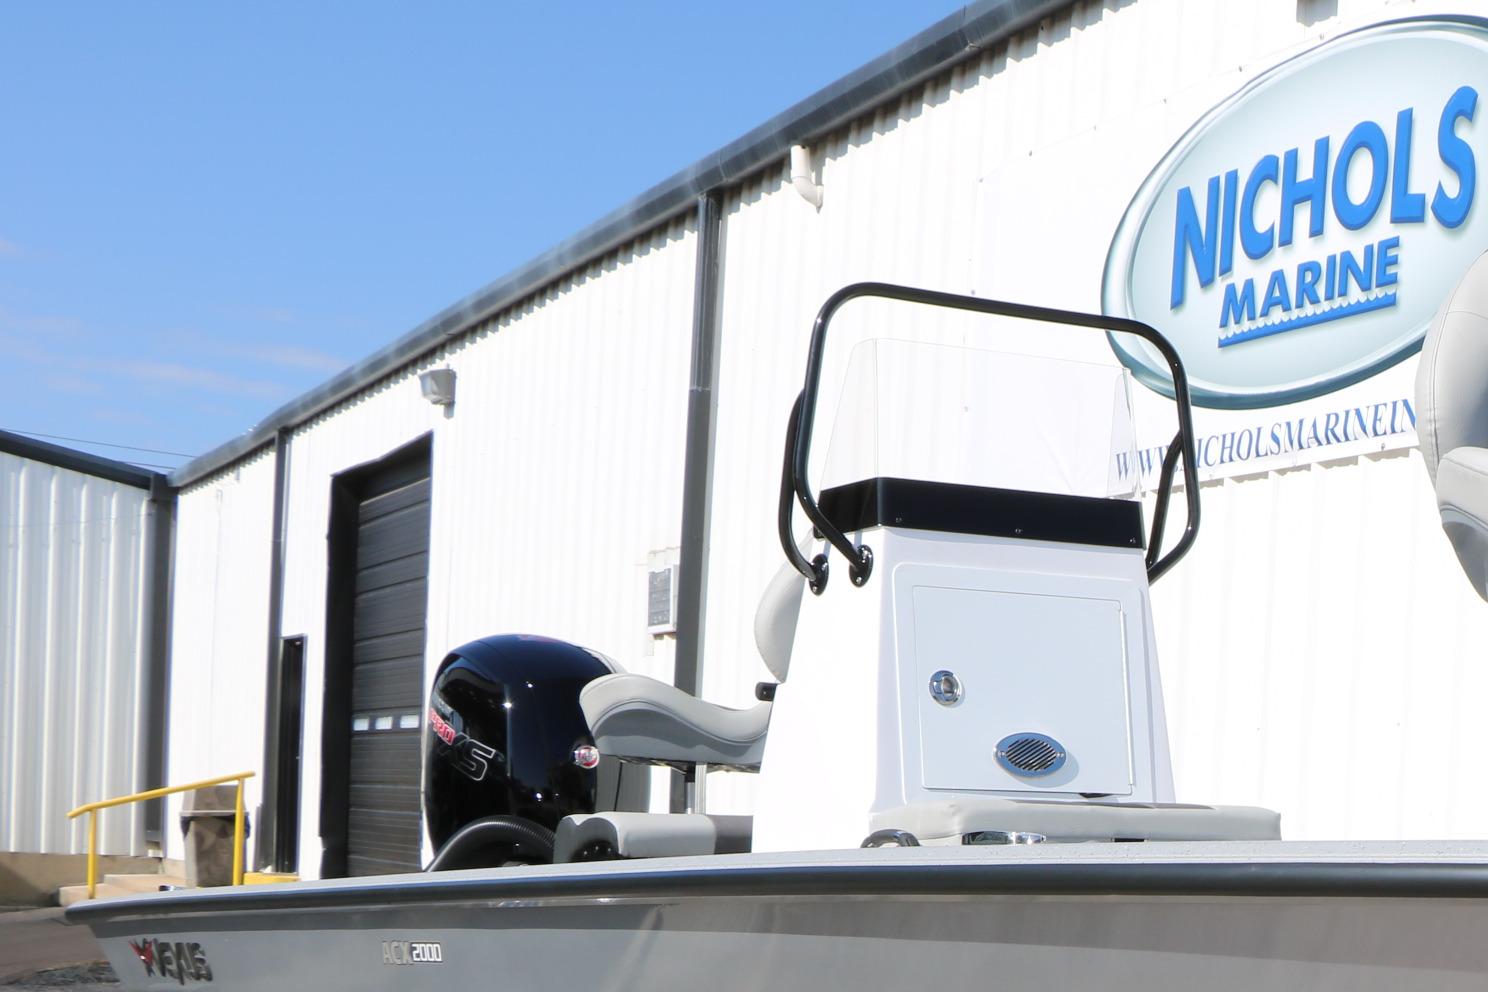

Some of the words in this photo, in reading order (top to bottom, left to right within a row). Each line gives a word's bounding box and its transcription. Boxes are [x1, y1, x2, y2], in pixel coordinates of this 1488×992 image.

[1170, 85, 1479, 311] NICHOLS
[1218, 235, 1400, 329] MARINE
[1116, 398, 1416, 480] WW.ICHOLSMARINEIN
[410, 942, 442, 962] 2000
